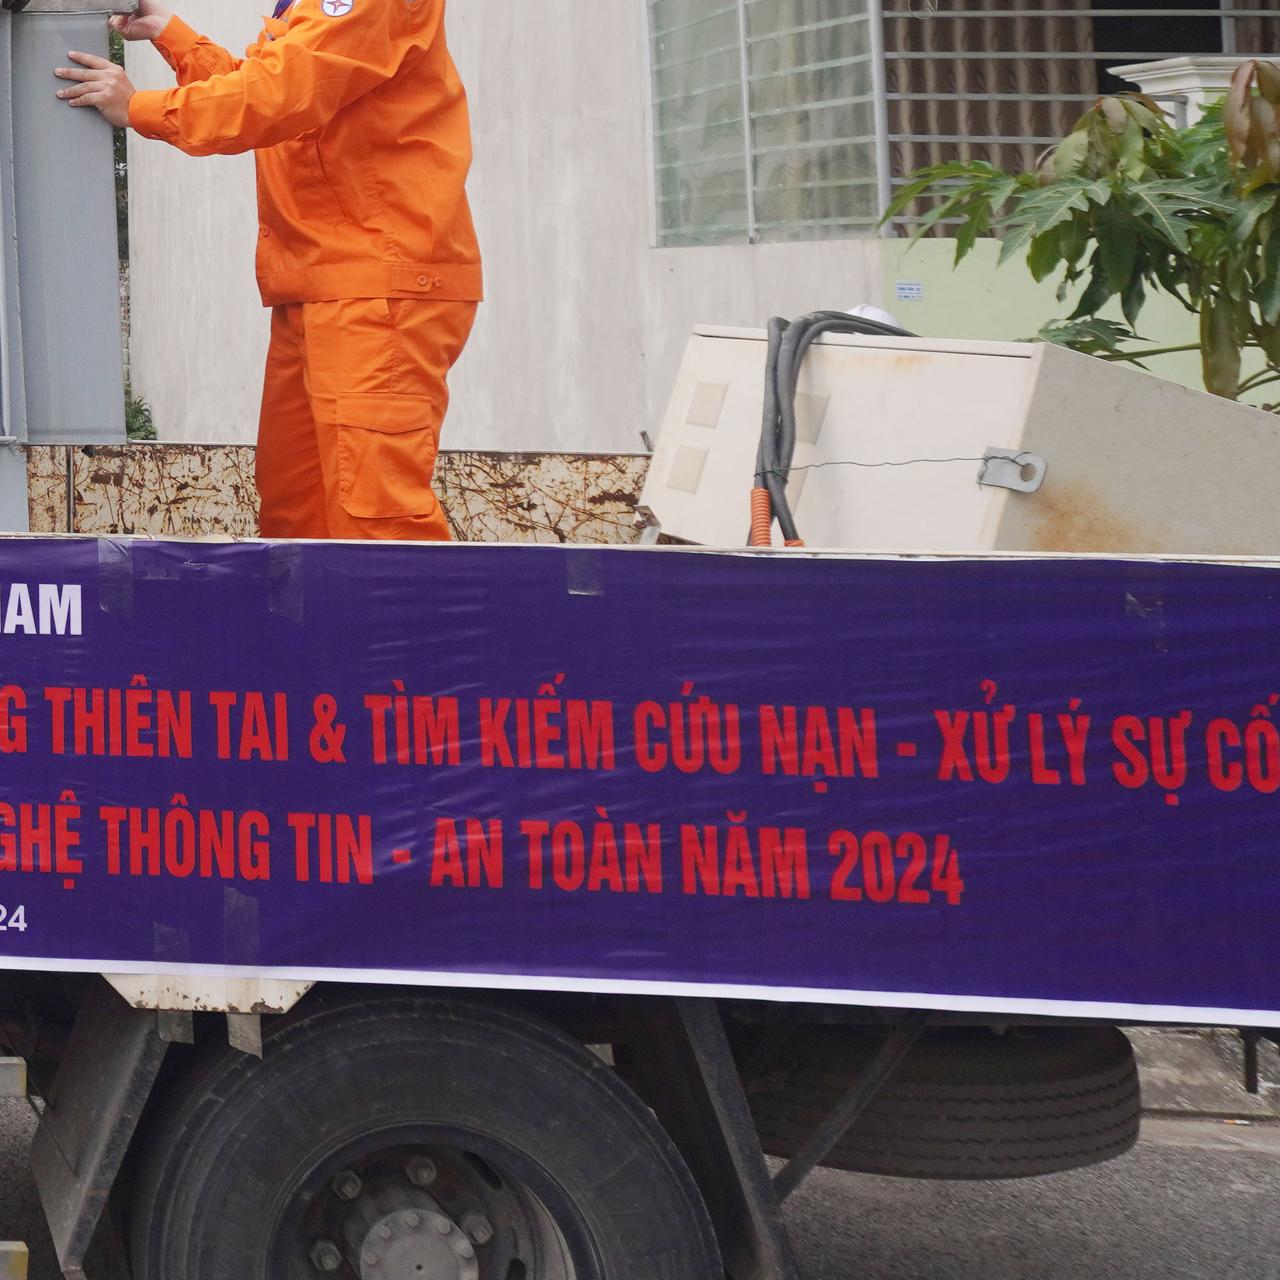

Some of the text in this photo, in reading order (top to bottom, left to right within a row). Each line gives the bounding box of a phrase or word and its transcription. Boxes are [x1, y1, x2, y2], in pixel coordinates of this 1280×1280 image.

[44, 673, 193, 759] THIÊN
[209, 691, 289, 762] TAI
[308, 693, 347, 763] &
[364, 679, 461, 767] TÌM
[479, 673, 615, 771] KIẾM
[633, 681, 741, 775] CỨU
[759, 704, 879, 794] NẠN
[897, 742, 917, 757] -
[933, 679, 1016, 784] XỬ
[1028, 698, 1091, 786] LÝ
[1111, 710, 1193, 806] SỰ
[1206, 693, 1280, 794] CỐ
[99, 793, 270, 882] THÔNG
[288, 812, 374, 885] TIN
[392, 850, 411, 864] -
[430, 817, 504, 889] AN
[521, 805, 663, 895] TOÀN
[680, 810, 811, 901] NĂM
[827, 829, 965, 906] 2024
